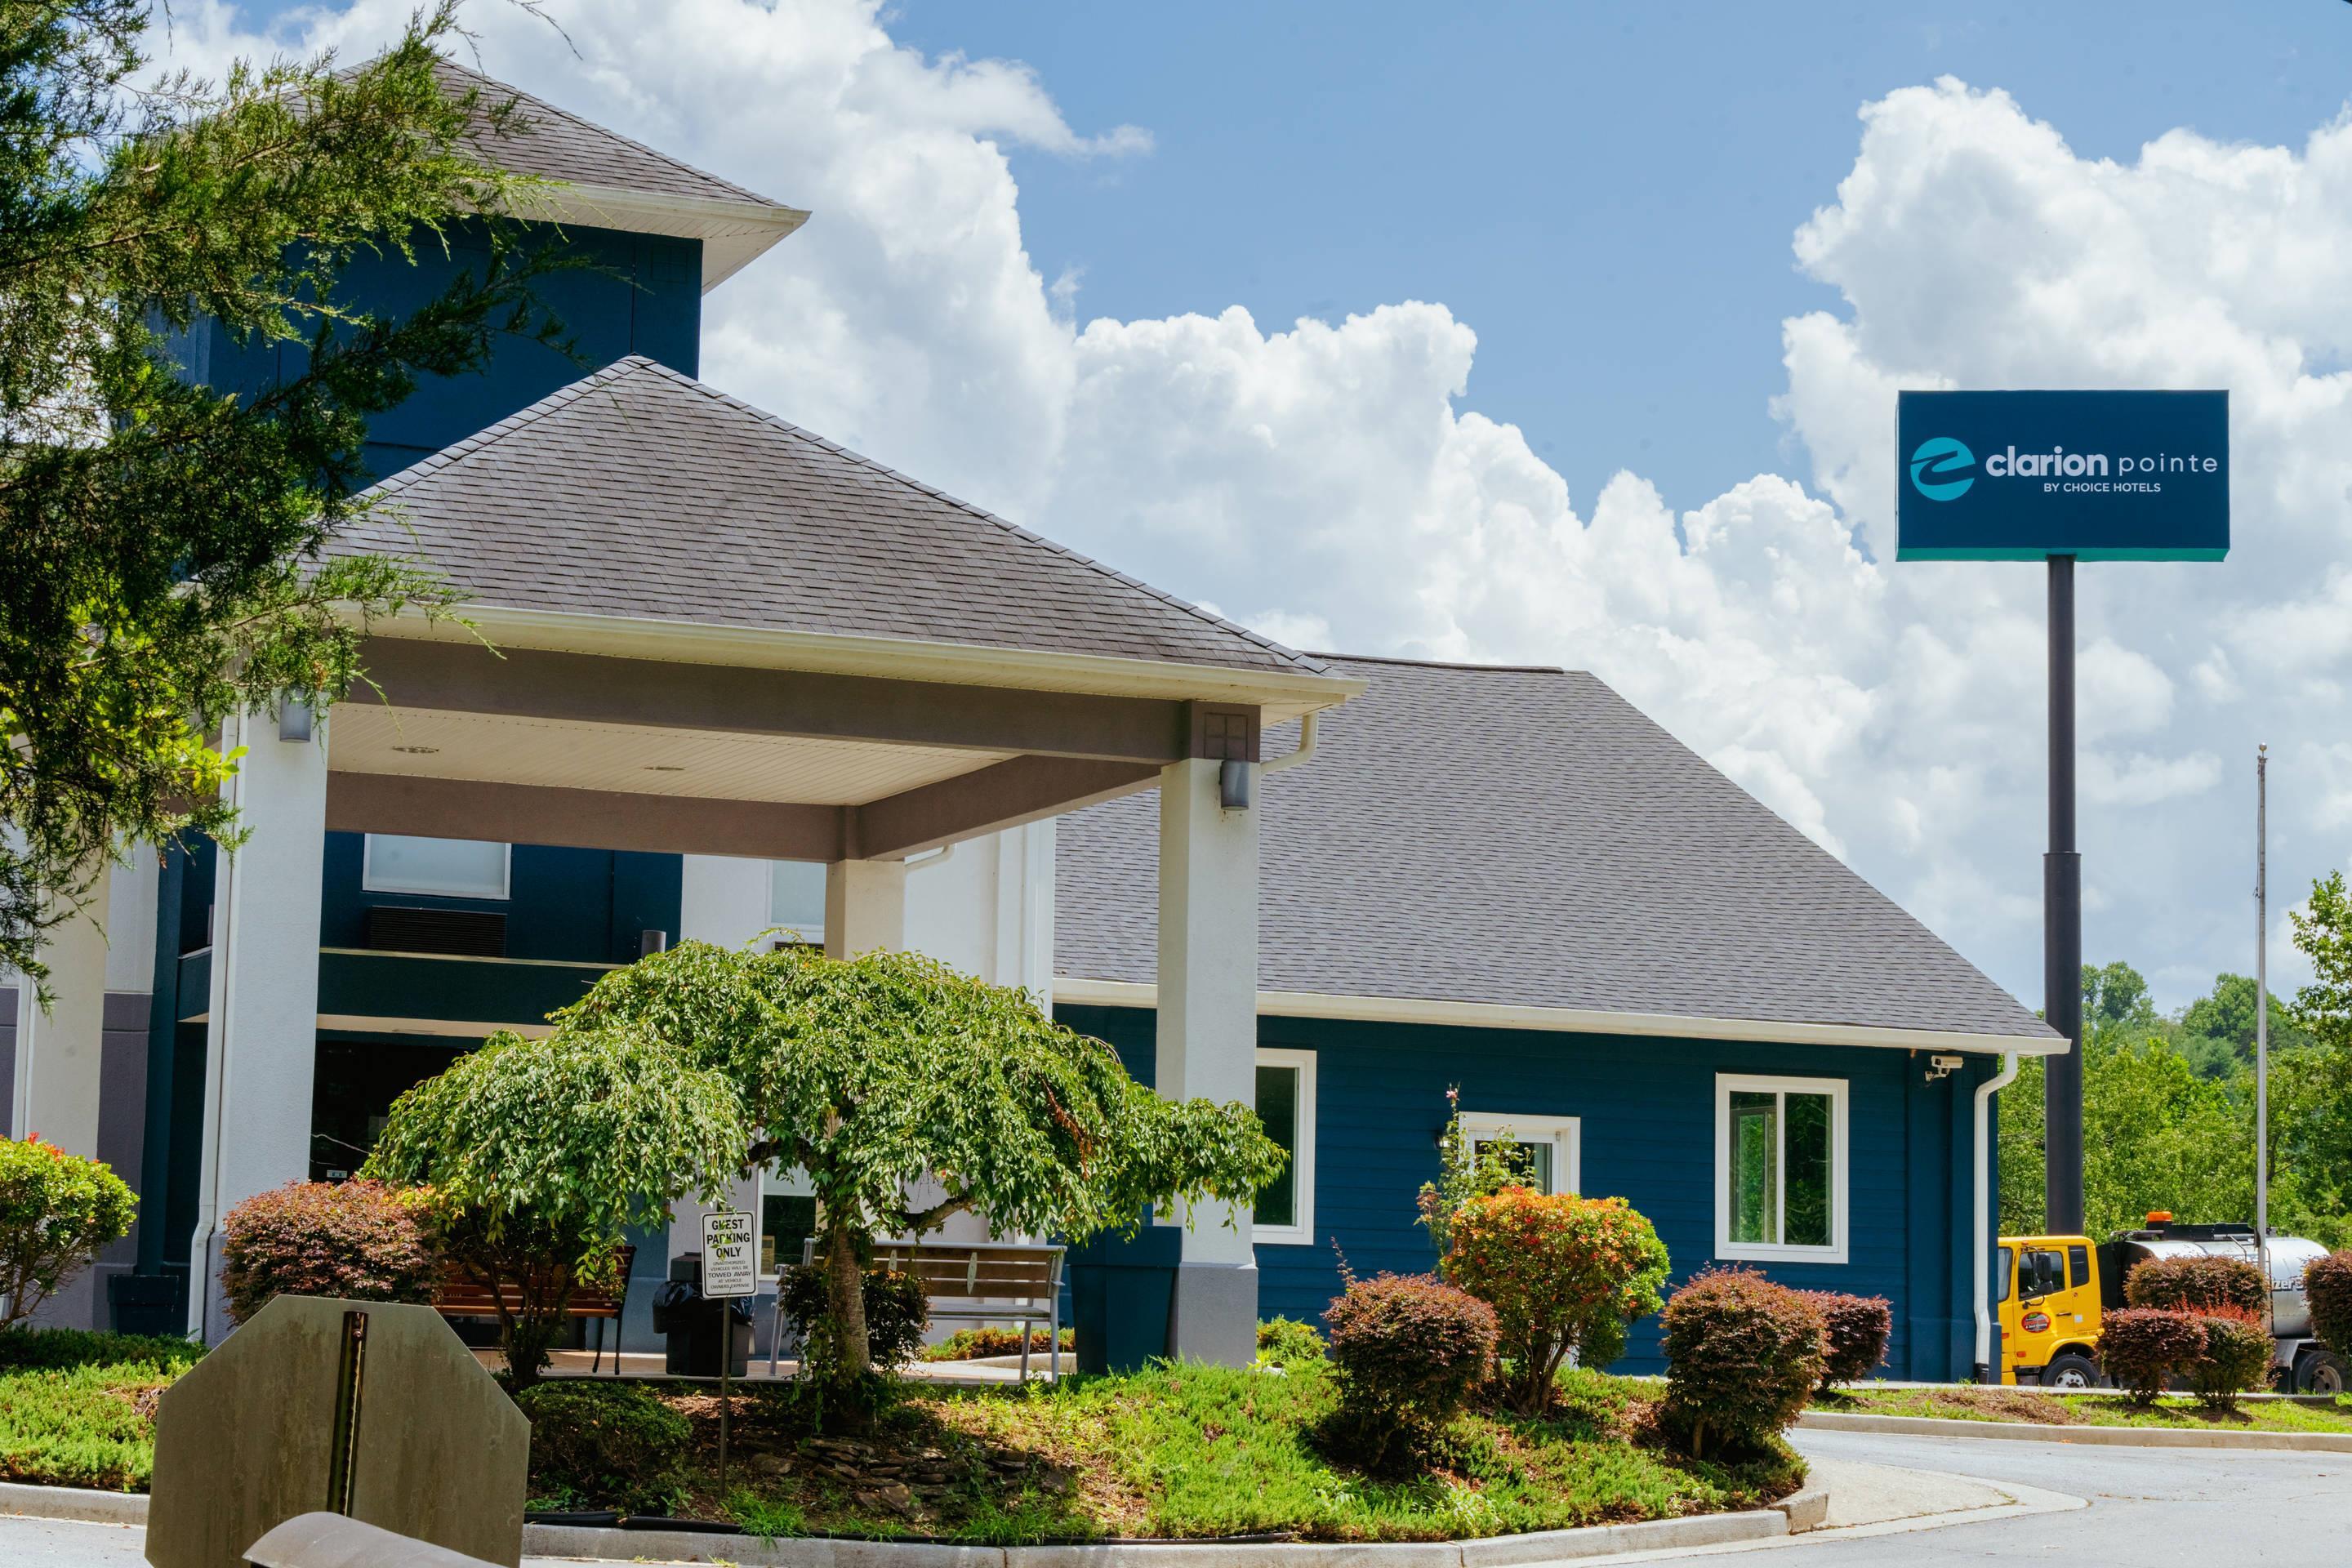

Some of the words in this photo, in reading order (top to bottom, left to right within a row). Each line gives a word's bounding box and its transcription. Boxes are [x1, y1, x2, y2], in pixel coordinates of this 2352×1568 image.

[1986, 445, 2109, 478] clarion
[2119, 452, 2218, 477] pointe
[2044, 483, 2060, 492] BY
[2063, 483, 2110, 493] CHOICE
[2114, 483, 2162, 493] HOTELS
[712, 1219, 744, 1230] GUEST
[707, 1232, 750, 1244] PARKING
[716, 1246, 742, 1258] ONLY
